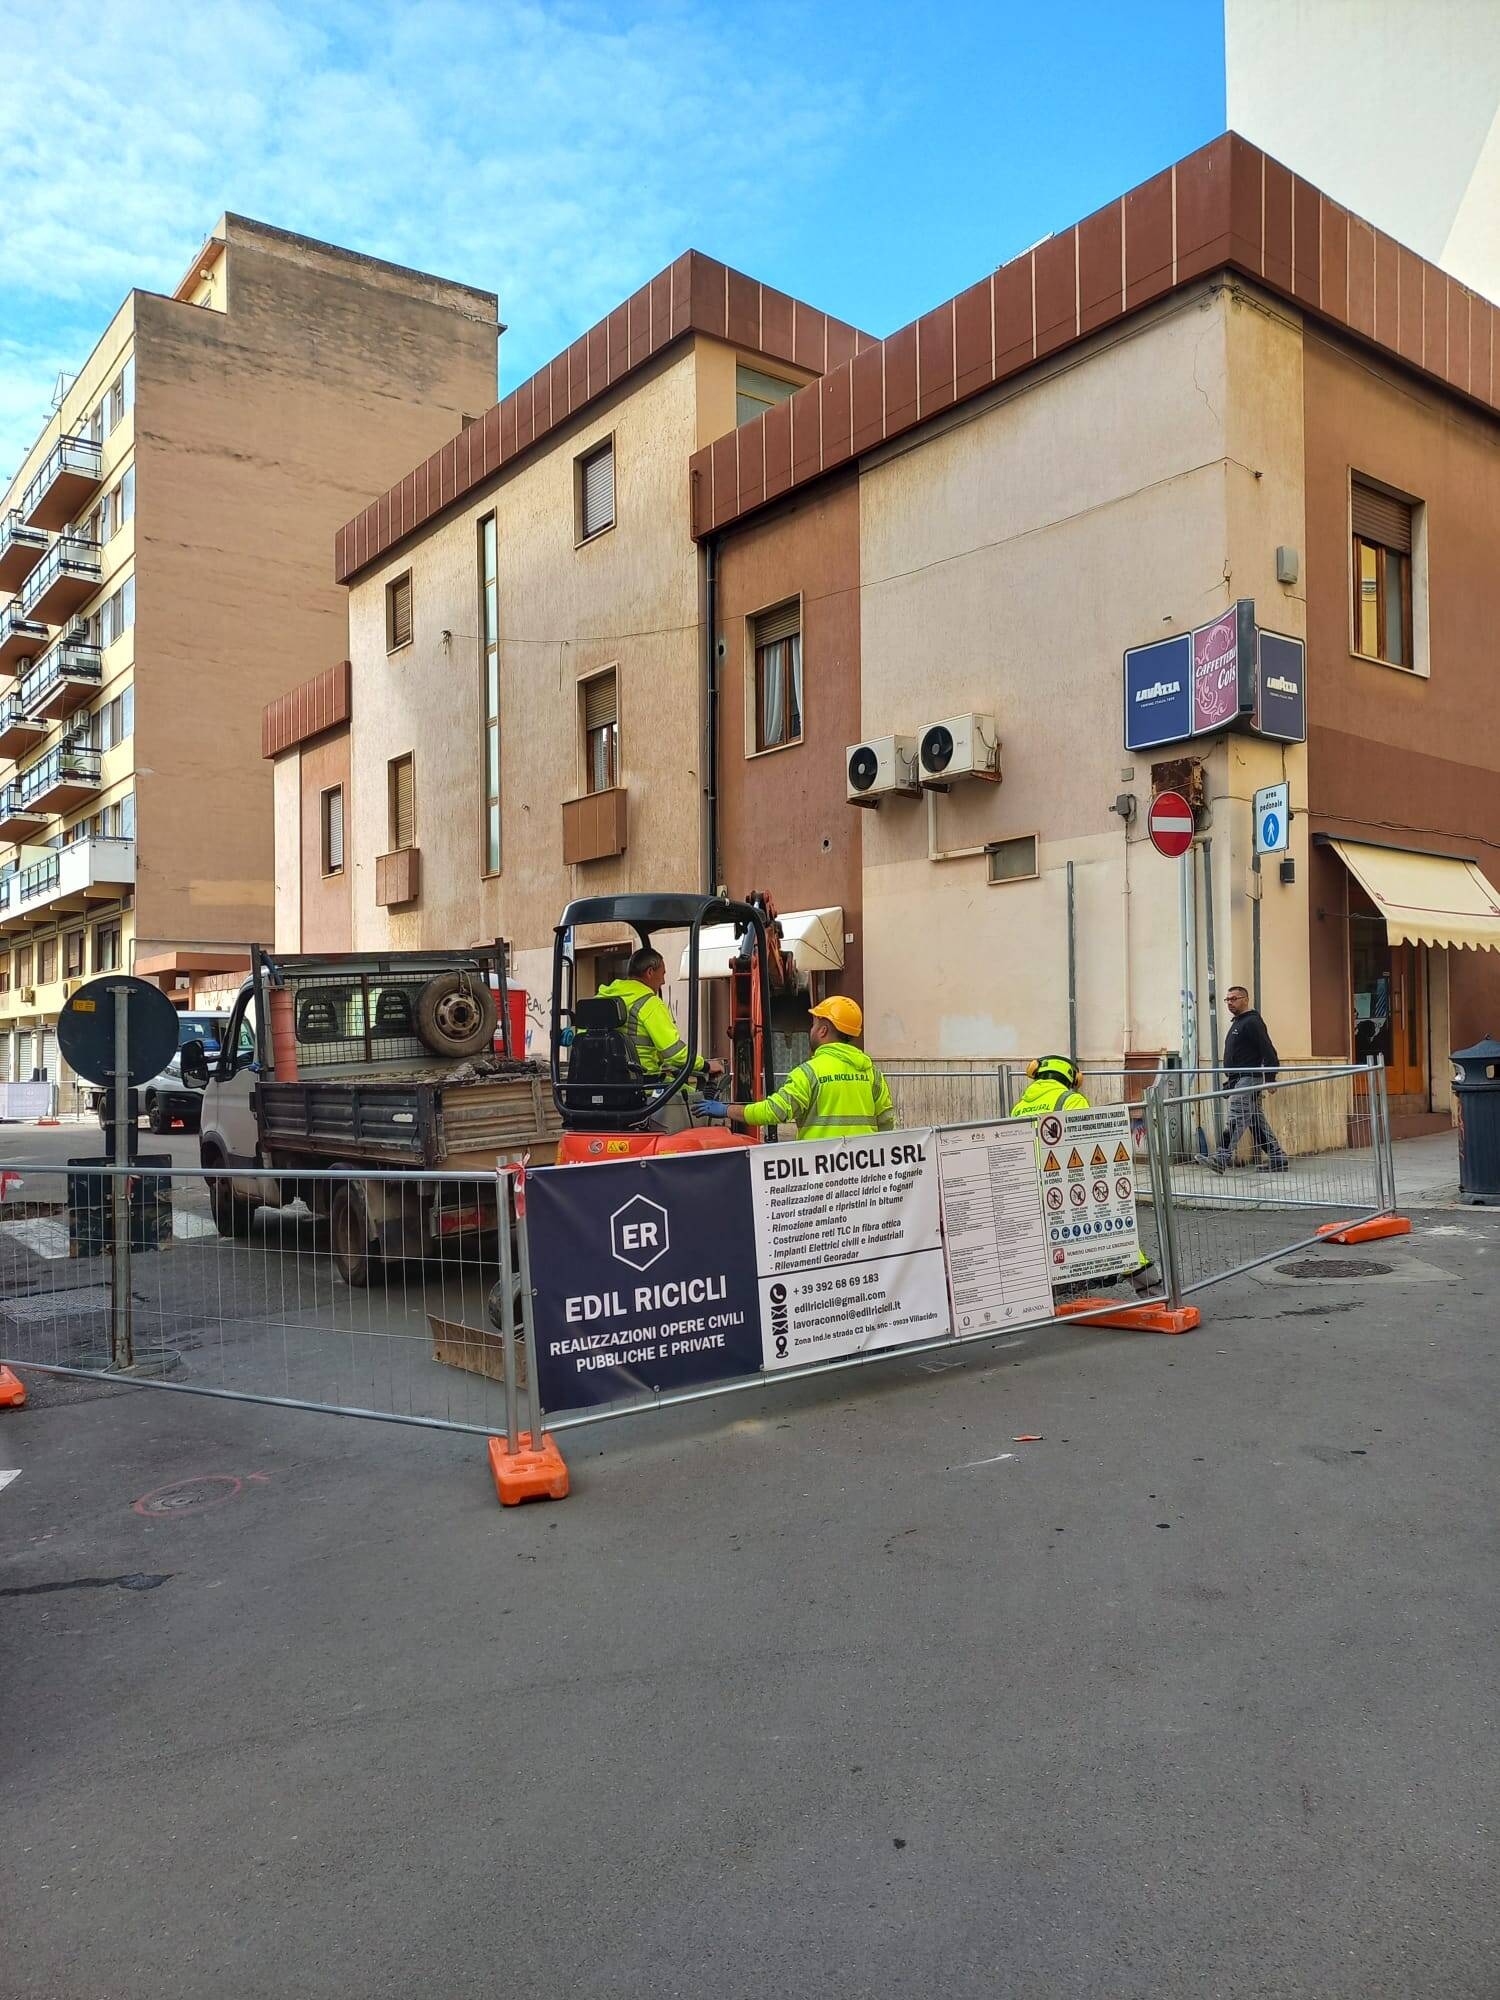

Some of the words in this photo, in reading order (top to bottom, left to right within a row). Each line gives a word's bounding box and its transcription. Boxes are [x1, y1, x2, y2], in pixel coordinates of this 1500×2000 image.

[1136, 681, 1180, 702] LAVAZZA
[1260, 800, 1282, 812] pedonale
[1266, 791, 1276, 799] area
[764, 1157, 809, 1180] EDIL
[815, 1148, 884, 1175] RICICLI
[891, 1144, 926, 1165] SRL
[770, 1181, 823, 1195] Realizzazione
[825, 1176, 858, 1188] condotte
[860, 1171, 886, 1184] idriche
[895, 1168, 923, 1180] fognarie
[770, 1194, 824, 1207] Realizzazione
[826, 1191, 833, 1200] di
[835, 1187, 860, 1199] allacci
[862, 1183, 880, 1194] idrici
[889, 1181, 913, 1192] fognari
[771, 1209, 796, 1220] Lavori
[798, 1205, 827, 1217] stradali
[836, 1199, 867, 1213] ripristini
[879, 1195, 903, 1205] bitume
[623, 1222, 658, 1250] ER
[773, 1221, 813, 1232] Rimozione
[816, 1216, 847, 1226] amianto
[773, 1232, 819, 1245] Costruzione
[822, 1230, 835, 1238] reti
[837, 1226, 850, 1236] TLC
[853, 1225, 859, 1233] in
[862, 1222, 879, 1232] fibra
[881, 1219, 901, 1228] ottica
[774, 1245, 807, 1258] Impianti
[809, 1241, 839, 1252] Elettrici
[842, 1236, 859, 1247] civili
[868, 1230, 903, 1243] industriali
[775, 1257, 821, 1271] Rilevamenti
[824, 1251, 858, 1263] Georadar
[802, 1285, 813, 1294] 39
[816, 1281, 833, 1292] 392
[835, 1279, 847, 1289] 68
[849, 1277, 860, 1286] 69
[863, 1273, 879, 1285] 183
[566, 1292, 627, 1322] EDIL
[635, 1275, 726, 1313] RICICLI
[795, 1290, 885, 1313] edilricicli@gmail.com
[794, 1301, 901, 1330] lavoraconnoi@edilricicli.it
[550, 1326, 656, 1356] REALIZZAZIONI
[660, 1318, 704, 1337] OPERE
[708, 1312, 744, 1328] CIVILI
[794, 1338, 811, 1346] Zona
[833, 1329, 853, 1339] strada
[855, 1326, 863, 1334] C2
[909, 1312, 938, 1322] Villacidro
[576, 1347, 655, 1373] PUBBLICHE
[659, 1345, 667, 1357] E
[671, 1335, 725, 1356] PRIVATE
